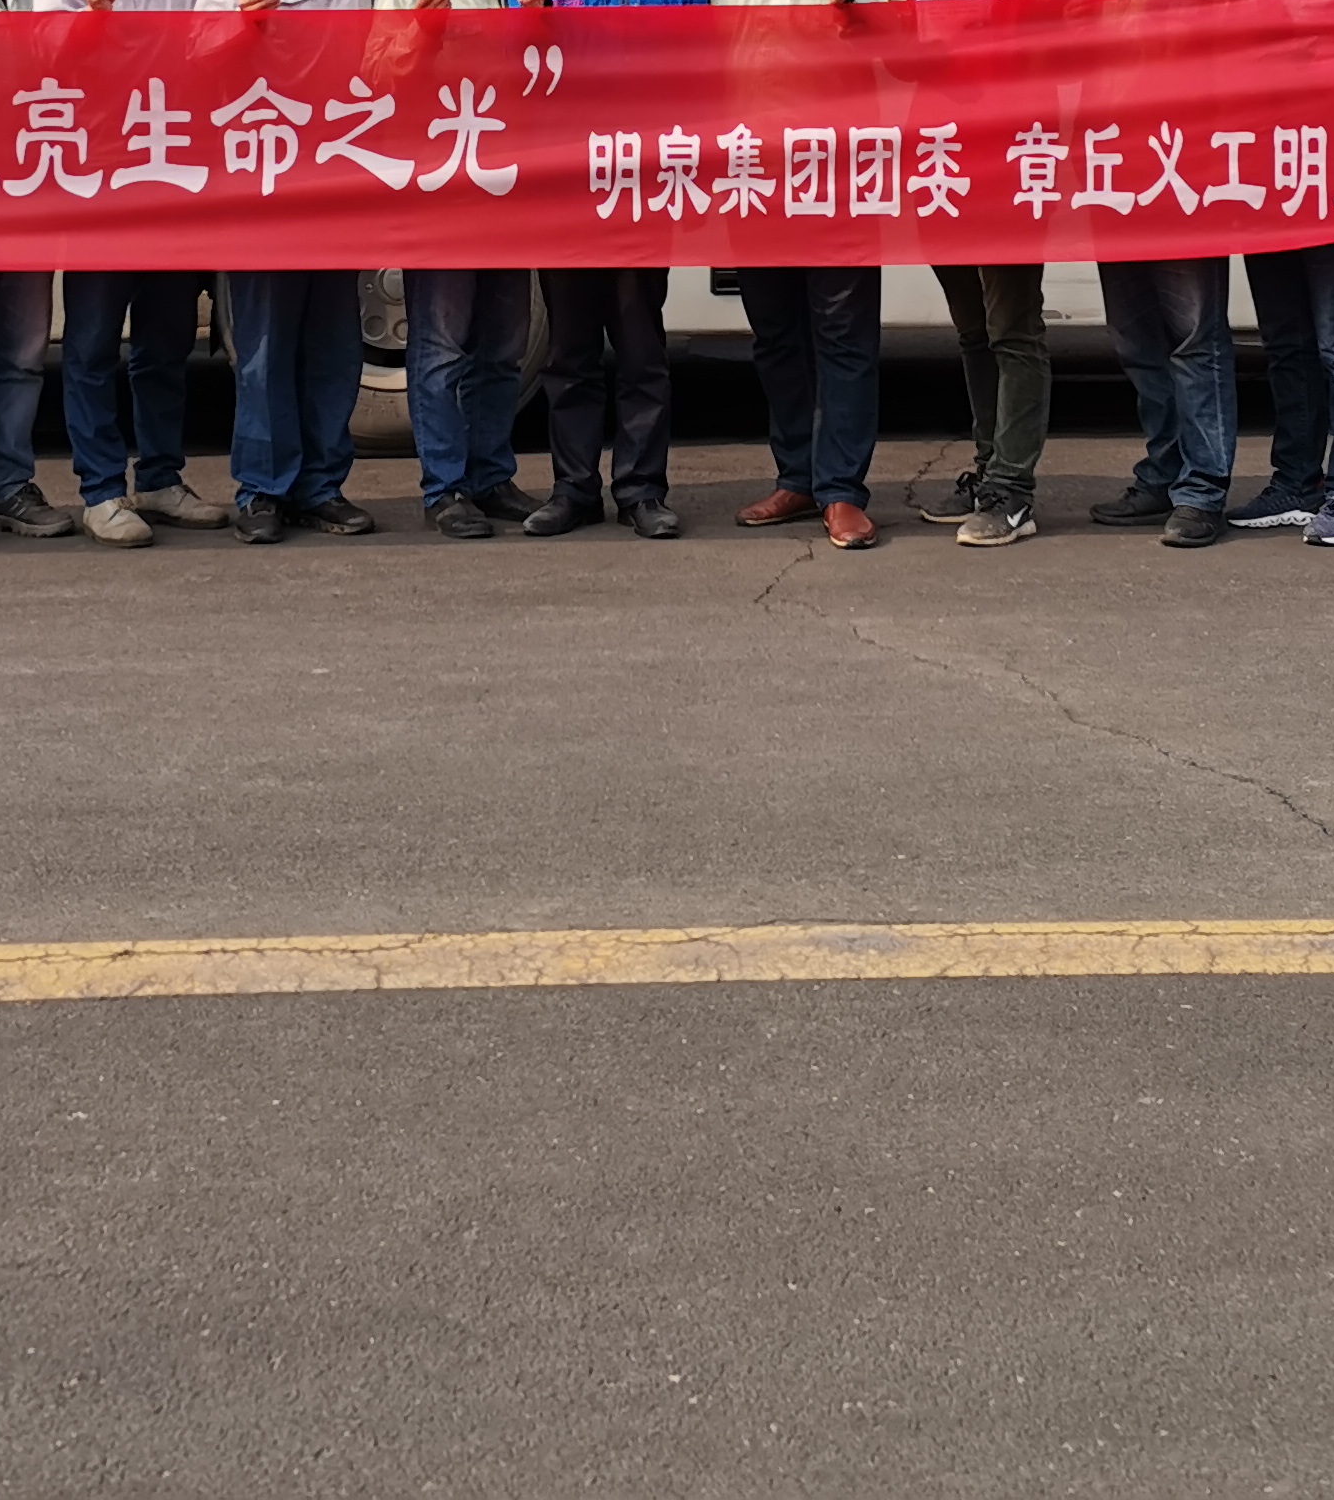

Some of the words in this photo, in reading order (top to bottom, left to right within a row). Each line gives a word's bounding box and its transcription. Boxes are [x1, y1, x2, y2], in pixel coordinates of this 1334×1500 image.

[588, 122, 971, 222] 明泉集团团委
